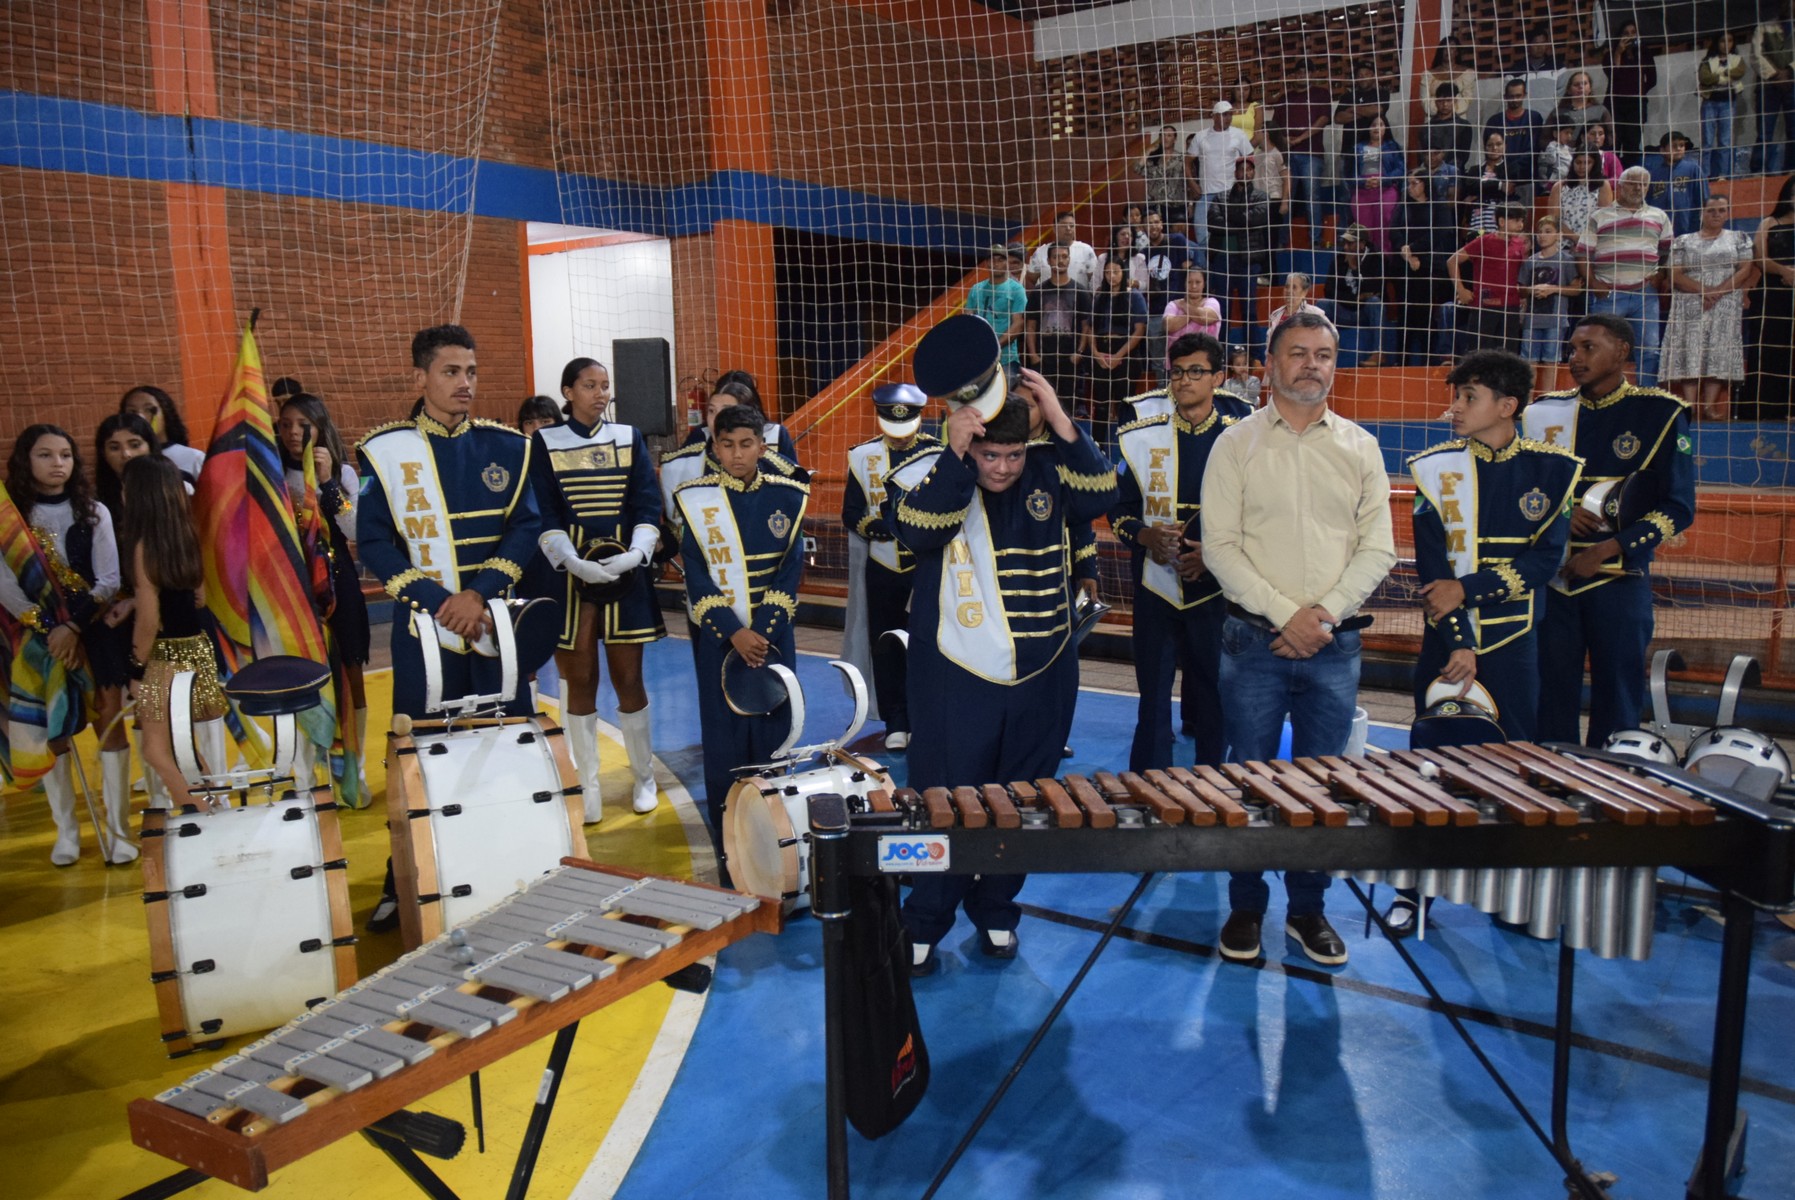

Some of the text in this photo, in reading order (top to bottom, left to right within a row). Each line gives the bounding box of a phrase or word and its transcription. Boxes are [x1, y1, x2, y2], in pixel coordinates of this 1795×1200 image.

[866, 455, 888, 517] FAM
[1145, 447, 1172, 527] FAM
[1439, 472, 1467, 570] FAM
[949, 538, 984, 629] MIG
